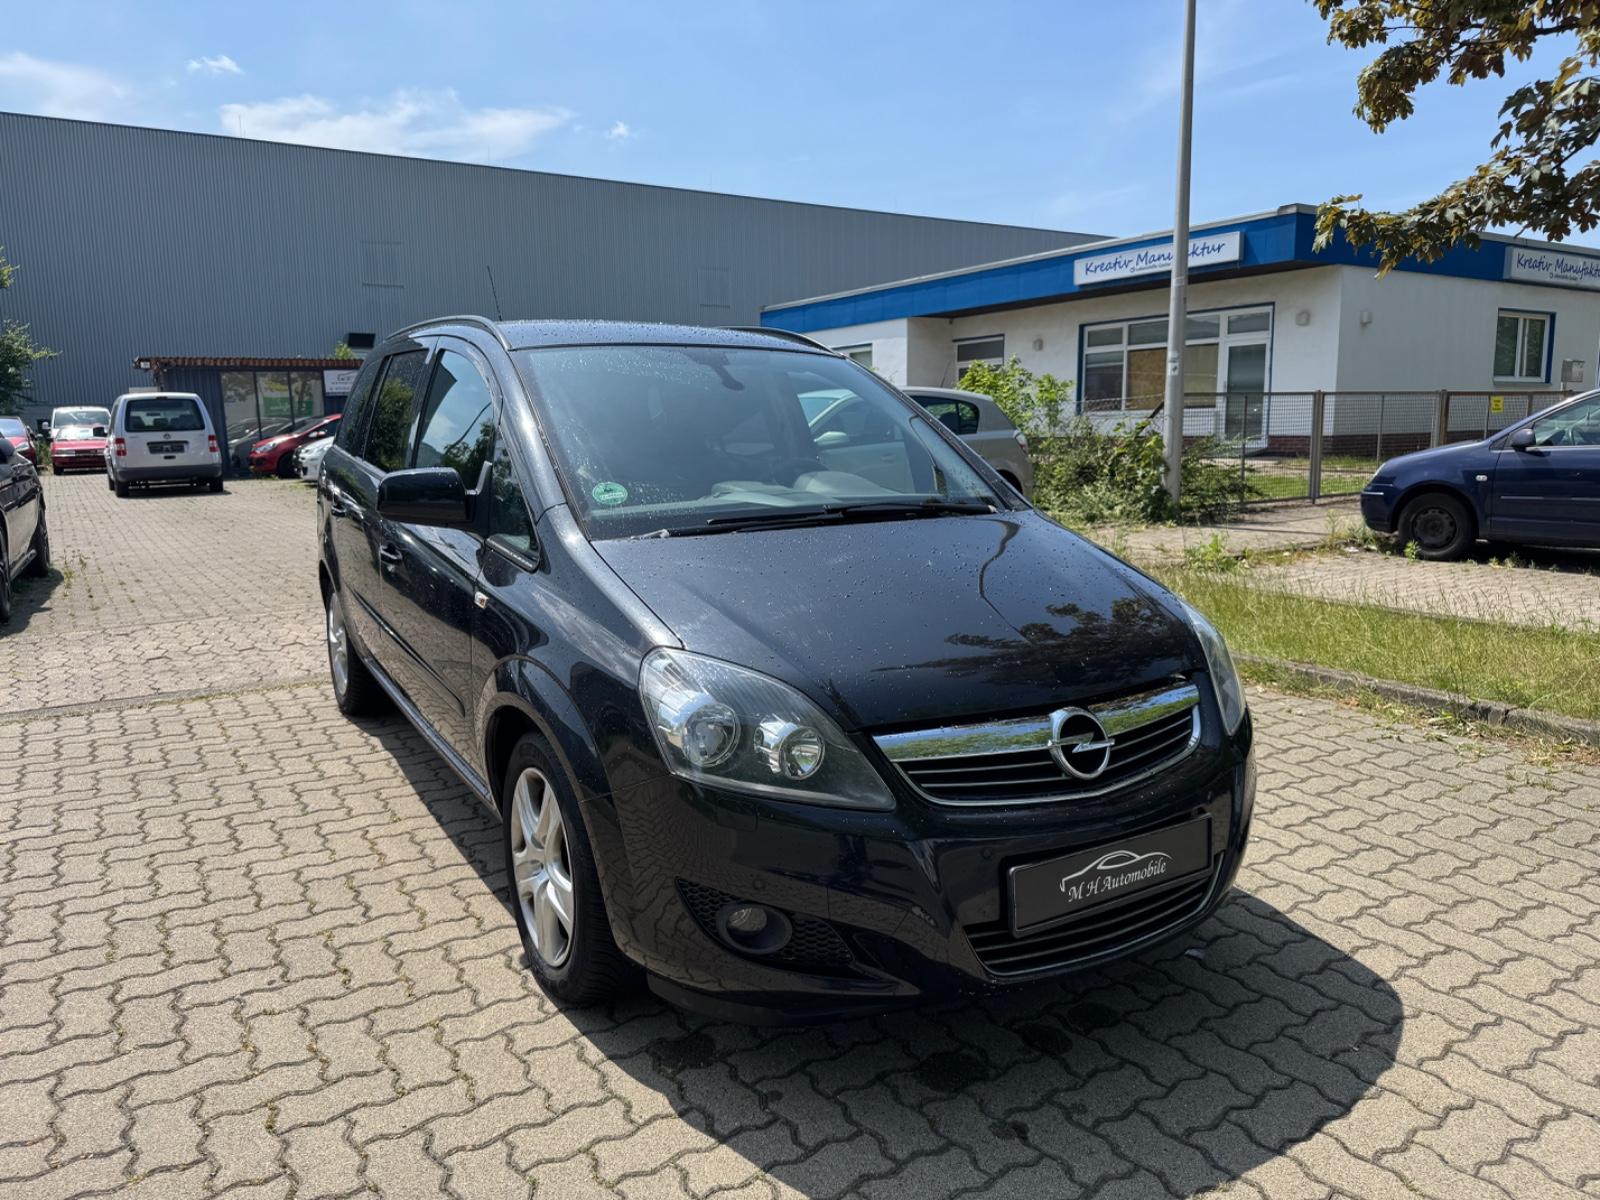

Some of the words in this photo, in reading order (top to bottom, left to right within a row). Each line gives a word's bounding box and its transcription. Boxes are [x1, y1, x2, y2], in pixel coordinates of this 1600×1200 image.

[1085, 255, 1133, 275] Kreativ
[1135, 242, 1226, 267] Manuktur
[1516, 253, 1552, 272] Kreativ
[1068, 882, 1085, 902] M
[1086, 876, 1101, 897] H
[1100, 857, 1167, 892] Automobile
